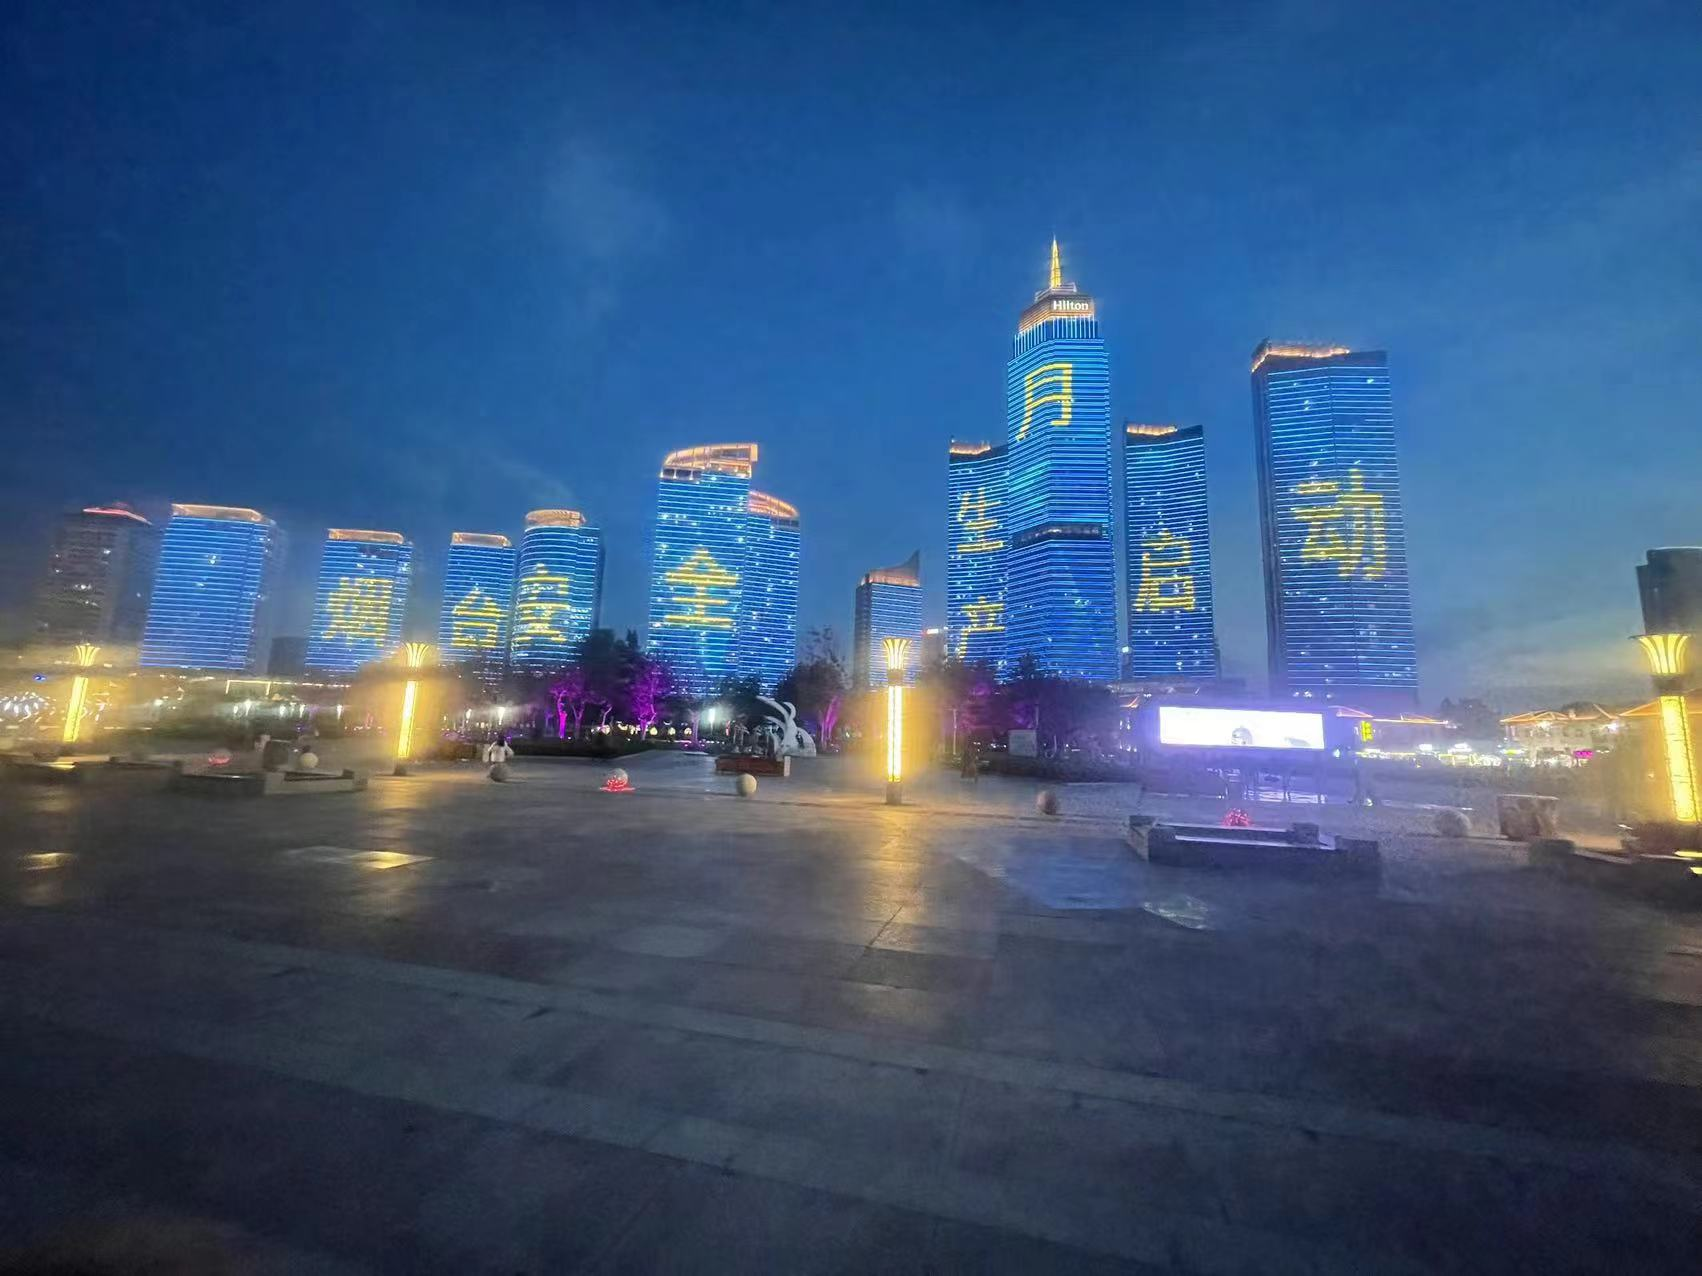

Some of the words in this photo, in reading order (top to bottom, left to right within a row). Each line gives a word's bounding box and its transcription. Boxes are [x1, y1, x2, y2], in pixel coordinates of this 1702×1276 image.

[1053, 299, 1089, 311] Hilton
[1016, 363, 1073, 442] 月
[664, 546, 737, 628] 全
